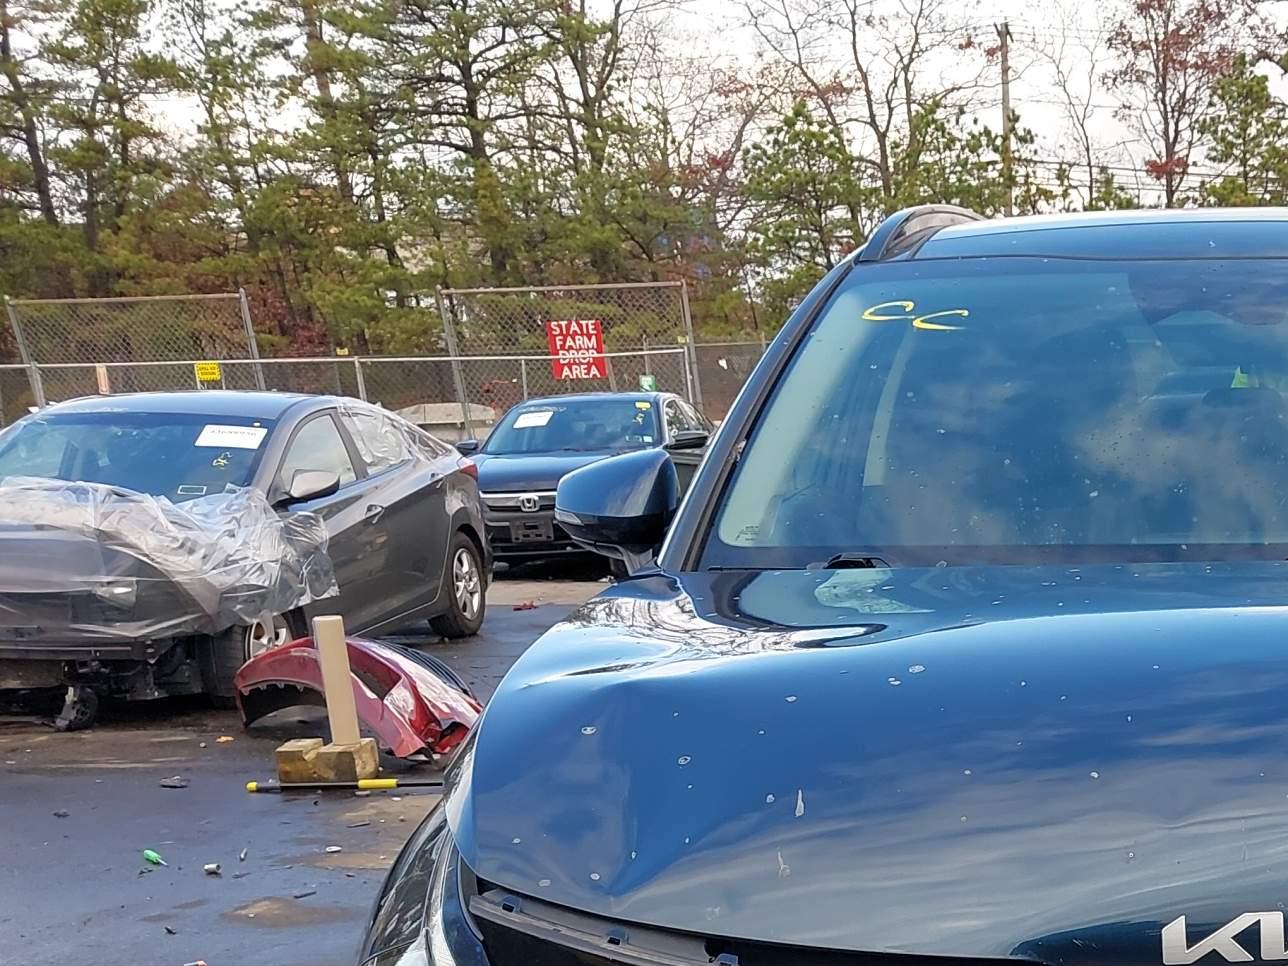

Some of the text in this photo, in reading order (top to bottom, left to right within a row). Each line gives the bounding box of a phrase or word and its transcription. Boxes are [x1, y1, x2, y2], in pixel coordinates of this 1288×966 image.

[550, 320, 597, 335] STATE
[555, 335, 598, 350] FARM
[558, 349, 598, 364] DROP
[561, 364, 601, 379] AREA
